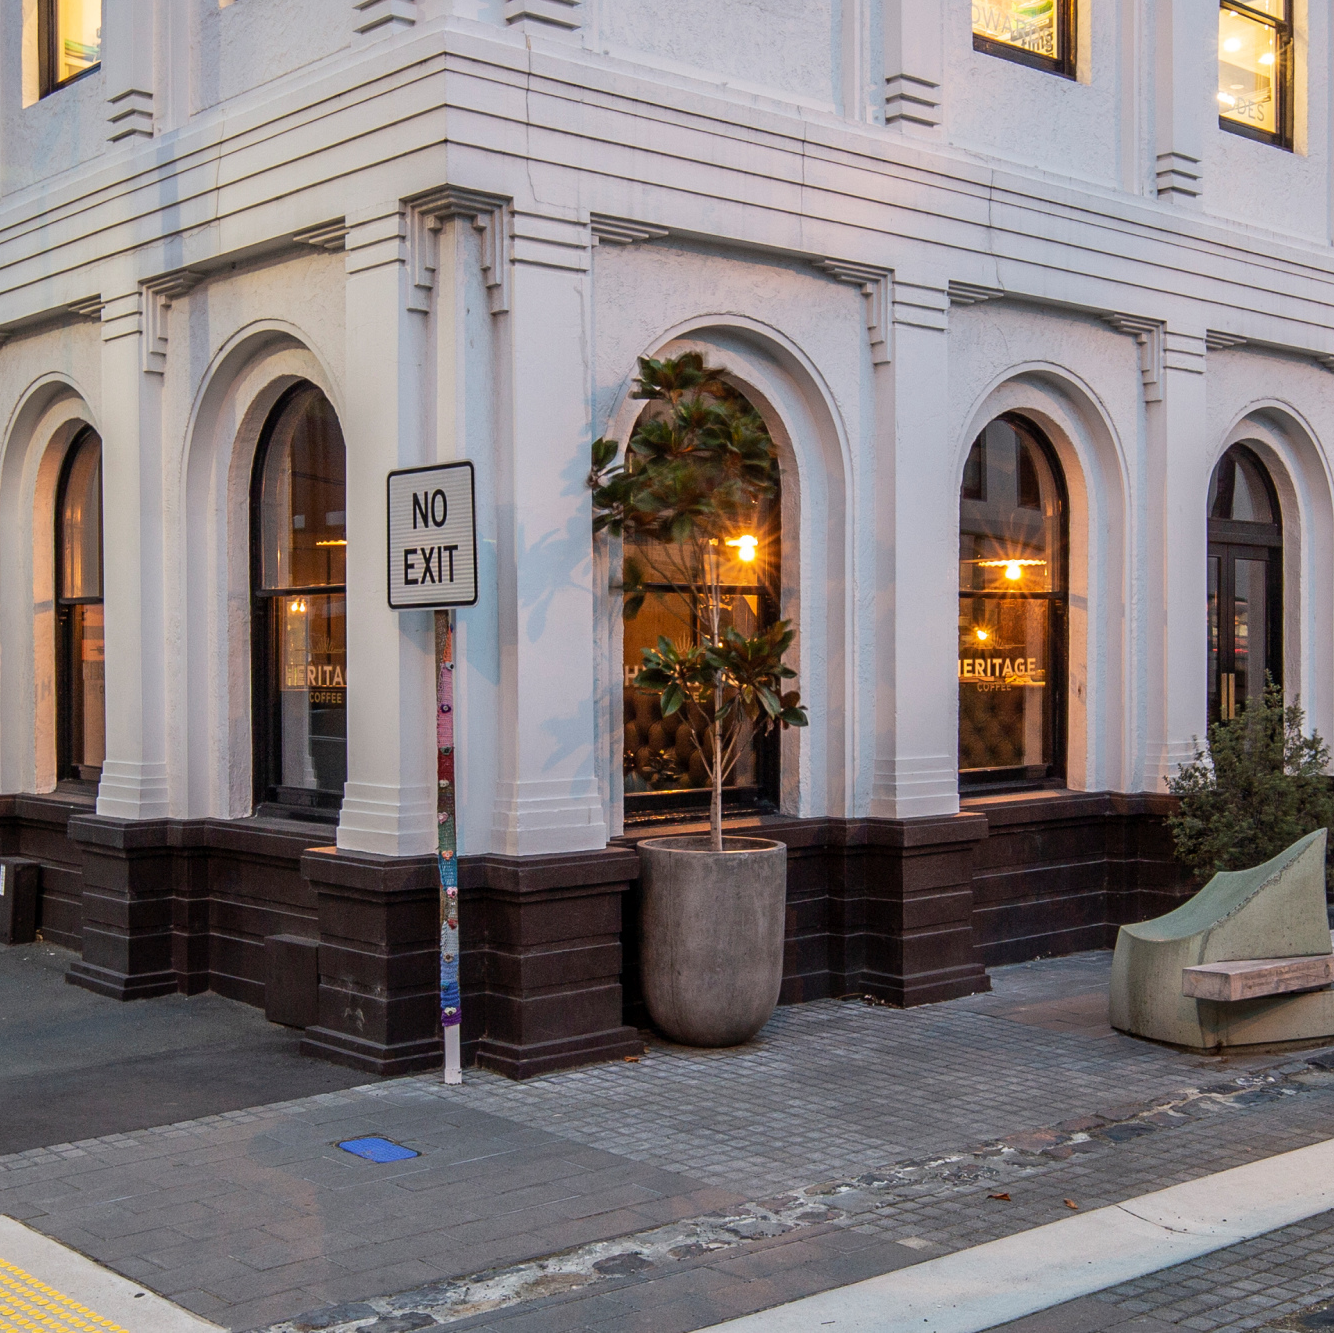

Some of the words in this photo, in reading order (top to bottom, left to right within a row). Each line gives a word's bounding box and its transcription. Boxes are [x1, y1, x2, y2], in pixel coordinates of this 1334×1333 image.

[412, 488, 448, 530] NO
[403, 544, 459, 586] EXIT
[286, 665, 347, 686] HERITA
[309, 692, 342, 703] COFFEE
[977, 682, 1012, 692] COFFEE
